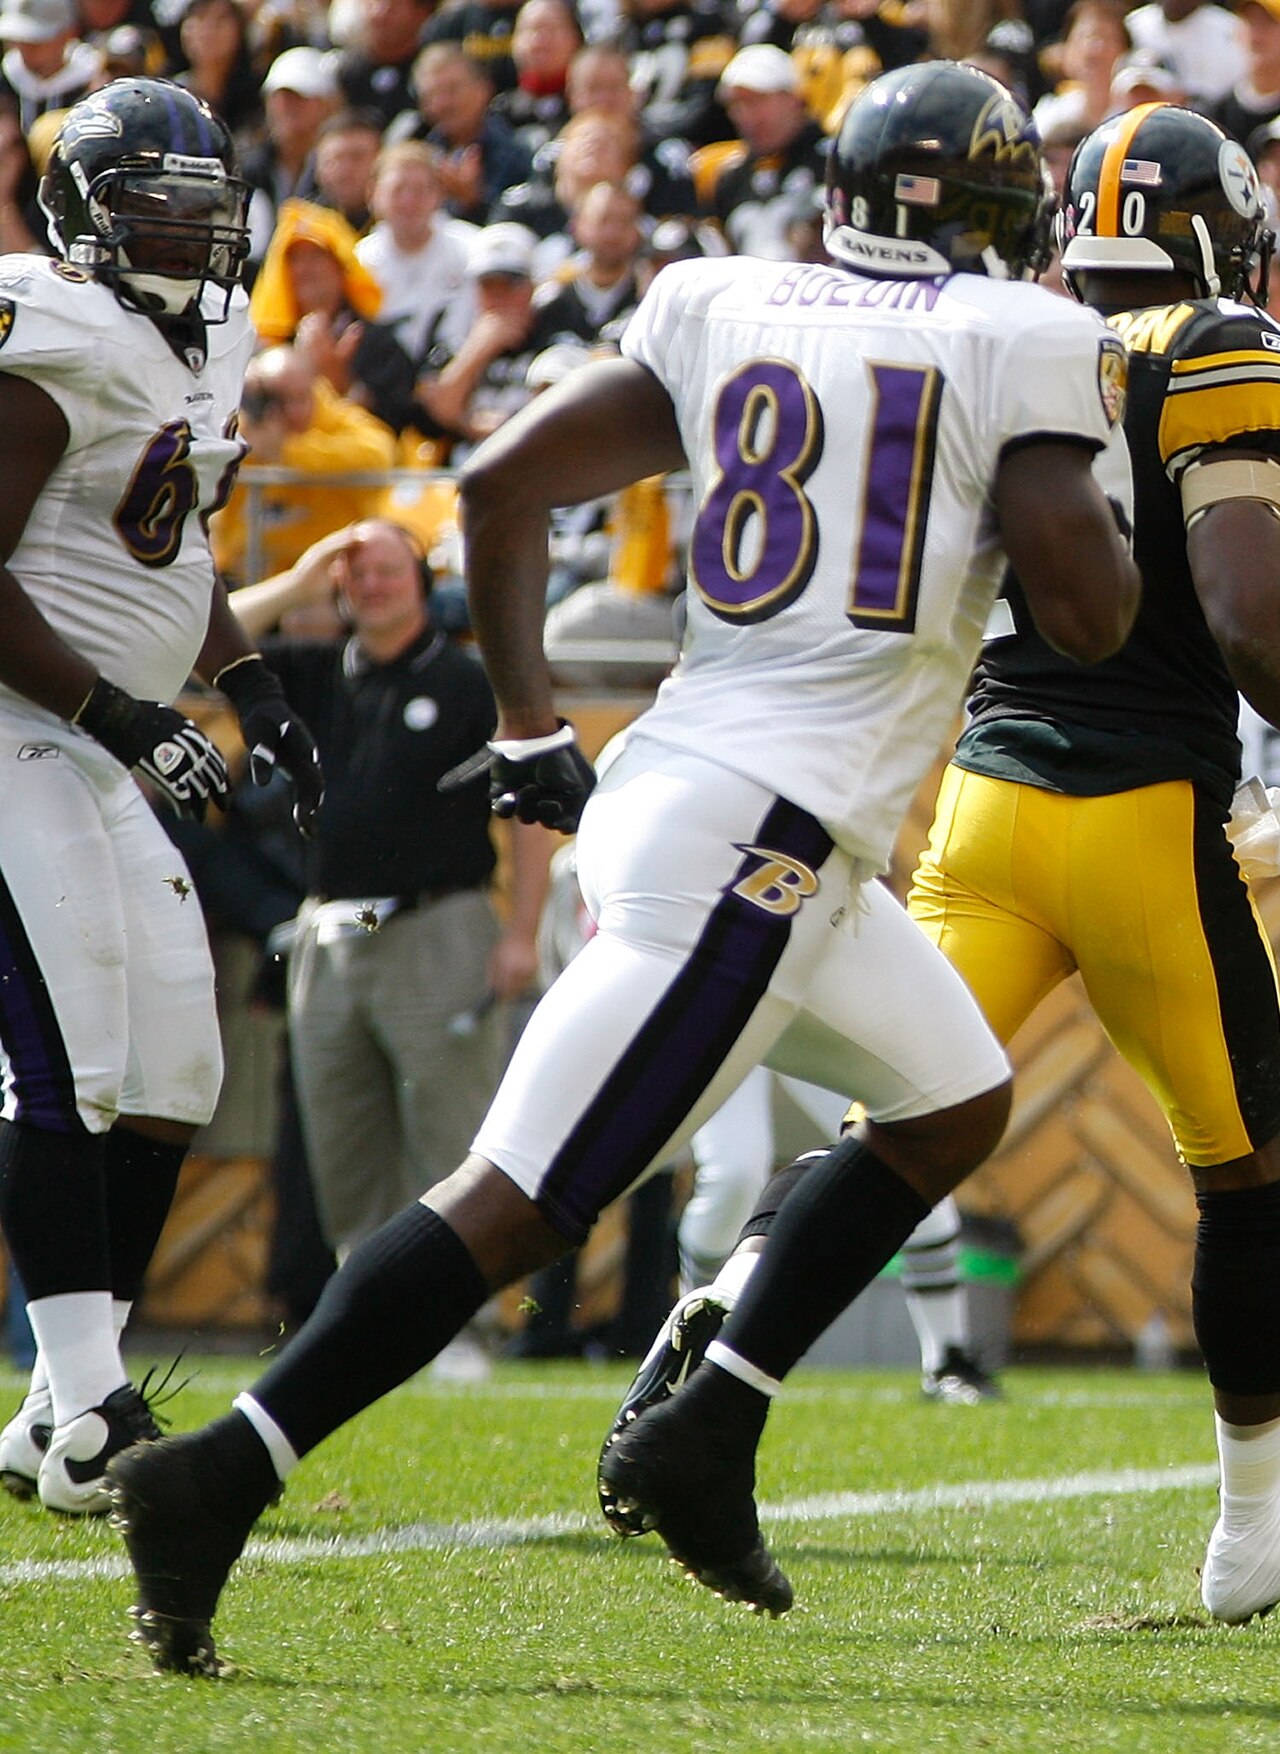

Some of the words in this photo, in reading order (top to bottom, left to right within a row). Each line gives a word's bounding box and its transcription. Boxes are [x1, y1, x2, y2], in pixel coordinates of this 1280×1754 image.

[1077, 191, 1146, 237] 20
[841, 234, 929, 264] RAVENS
[688, 355, 945, 634] 81
